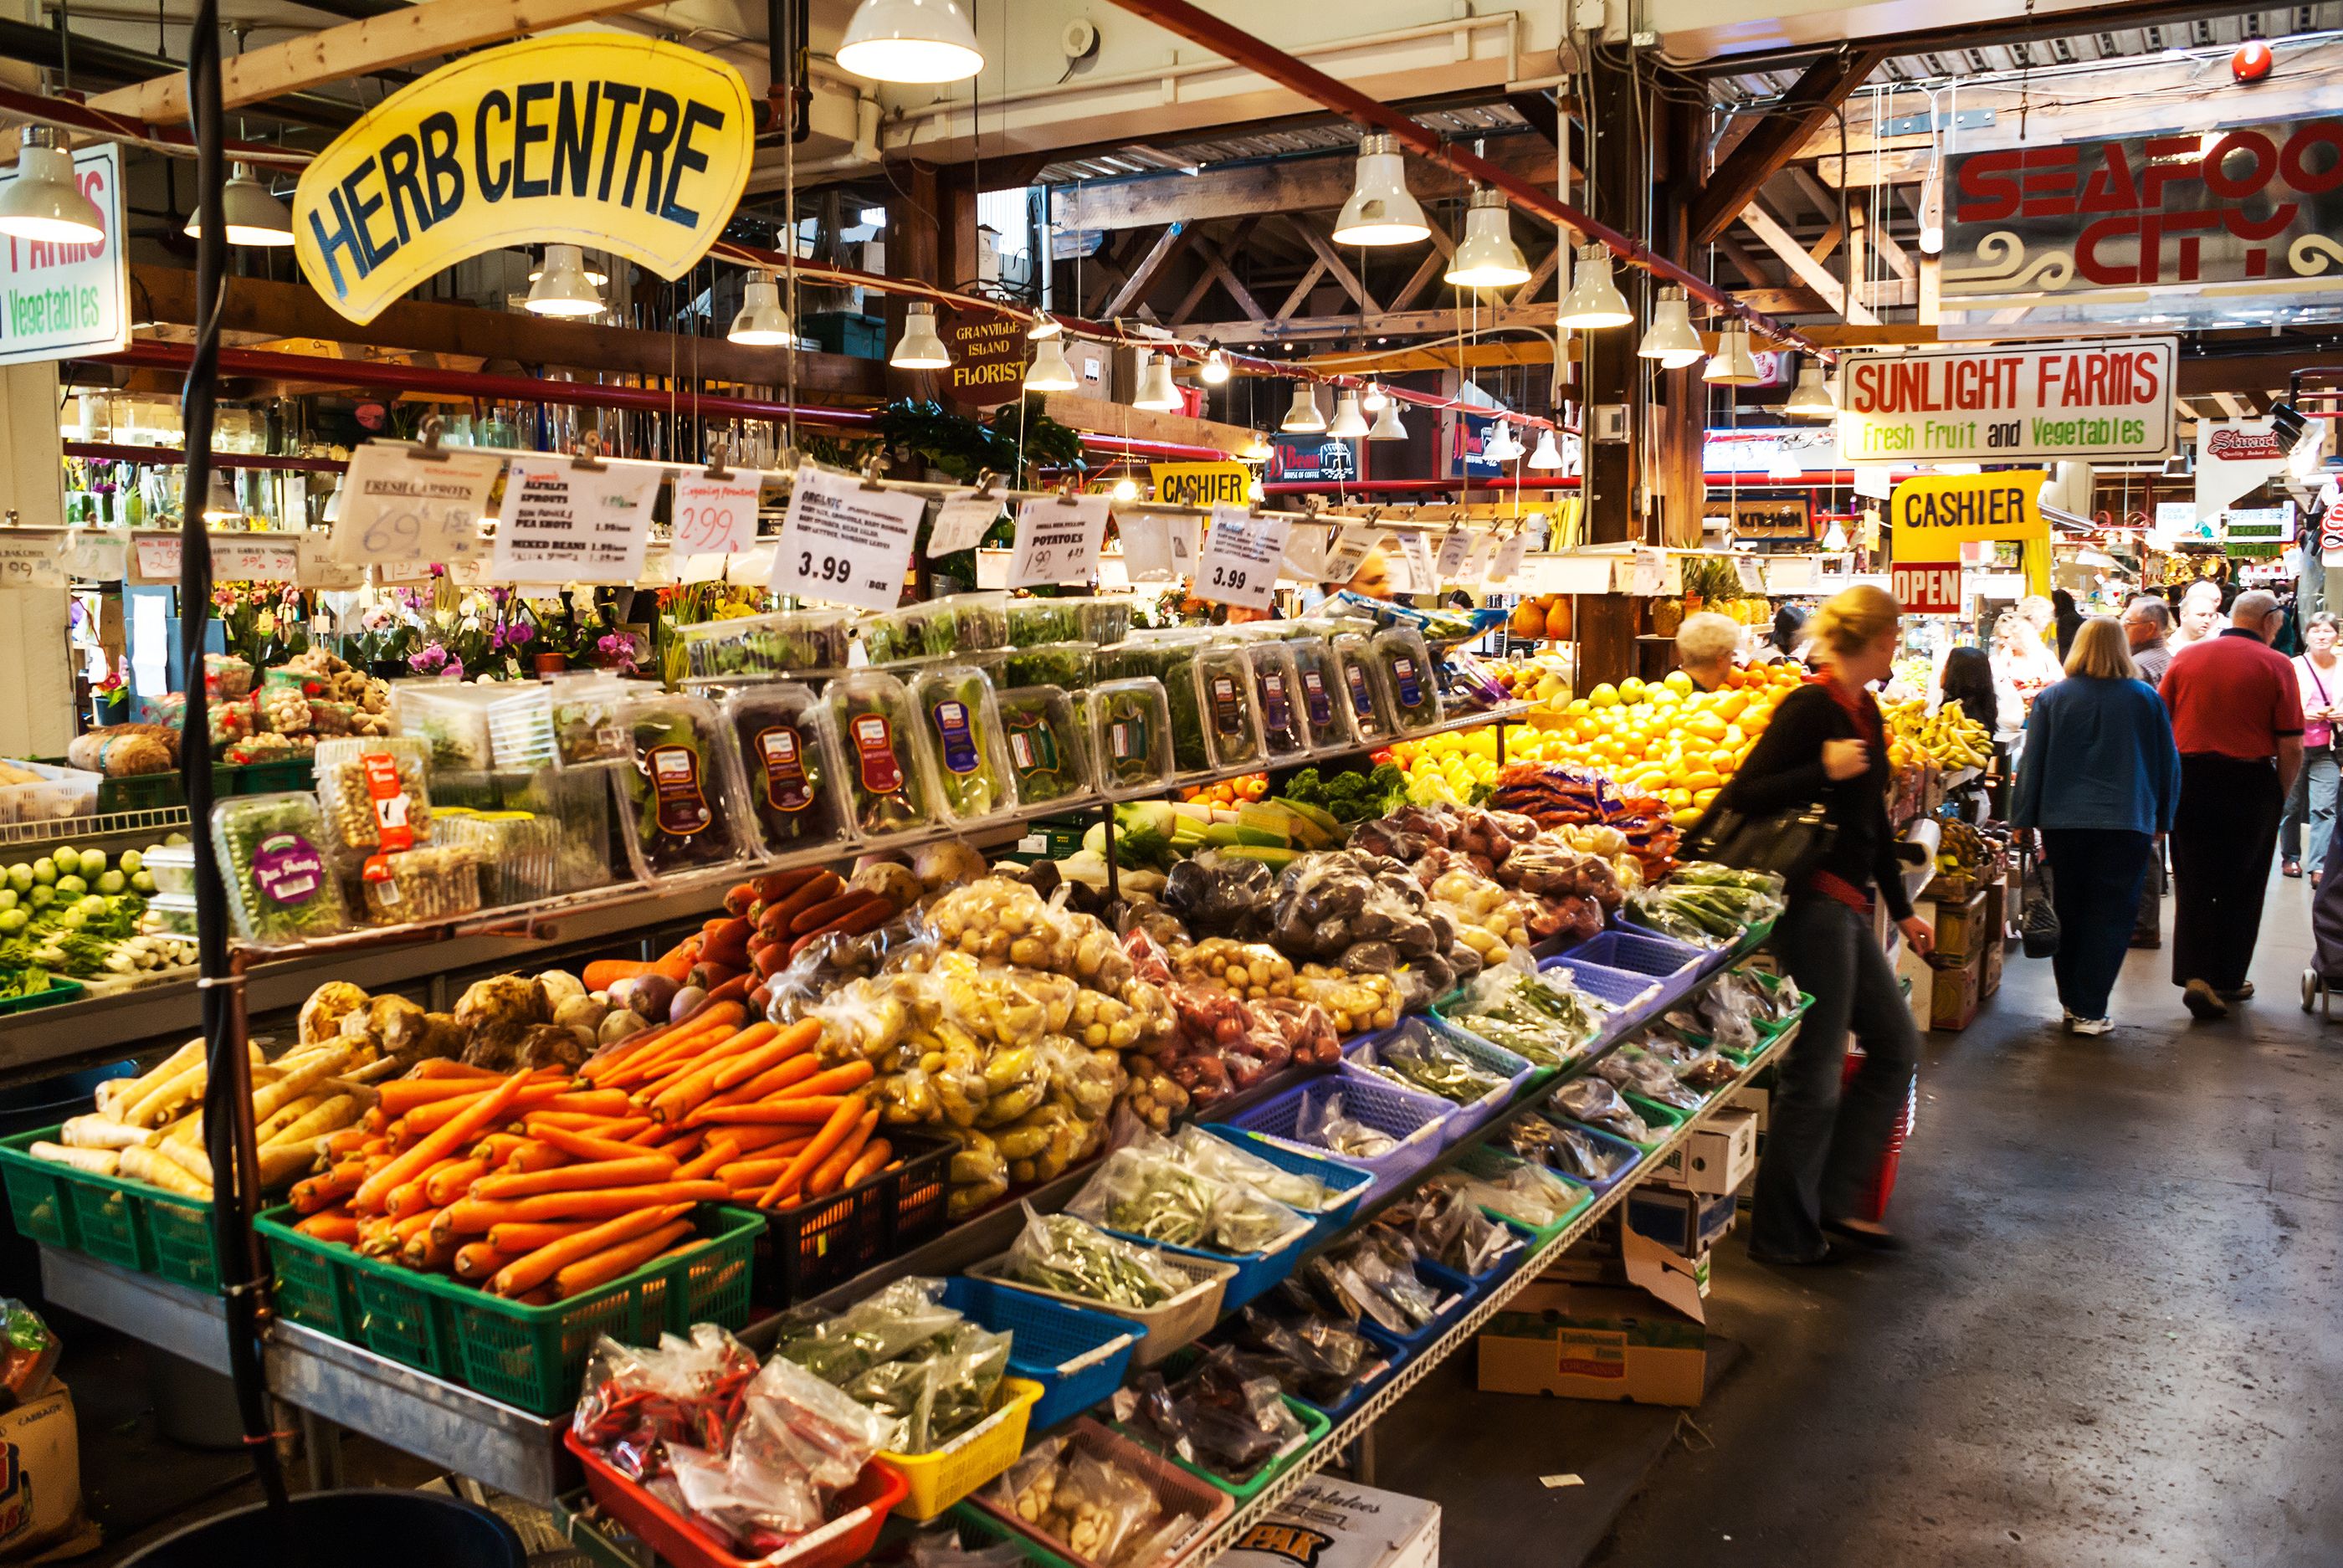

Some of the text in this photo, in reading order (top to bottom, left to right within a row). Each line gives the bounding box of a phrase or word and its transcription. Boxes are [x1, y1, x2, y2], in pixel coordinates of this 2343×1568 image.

[309, 110, 465, 300] HERB
[474, 79, 725, 229] CENTRE
[2074, 203, 2299, 286] CITY
[9, 283, 100, 339] Vegetables
[956, 320, 1021, 341] GRANVILLE
[968, 340, 1010, 357] ISLAND
[954, 361, 1028, 387] FLORIST
[1854, 351, 2159, 414] SUNLIGHT FARMS
[1863, 416, 2146, 452] Fresh Fruit and Vegetables
[1285, 444, 1320, 469] Bean
[1284, 470, 1320, 479] HOUSE OF COFFEE
[520, 494, 568, 504] SPROUTS
[1162, 473, 1243, 503] CASHIER
[1905, 487, 2025, 529] CASHIER
[1032, 533, 1084, 547] POTATOES
[2233, 545, 2275, 556] YOGURT
[798, 551, 852, 584] 3.99
[1212, 566, 1247, 590] 3.99
[1893, 569, 1960, 607] OPEN
[18, 1403, 62, 1426] CABBAGE
